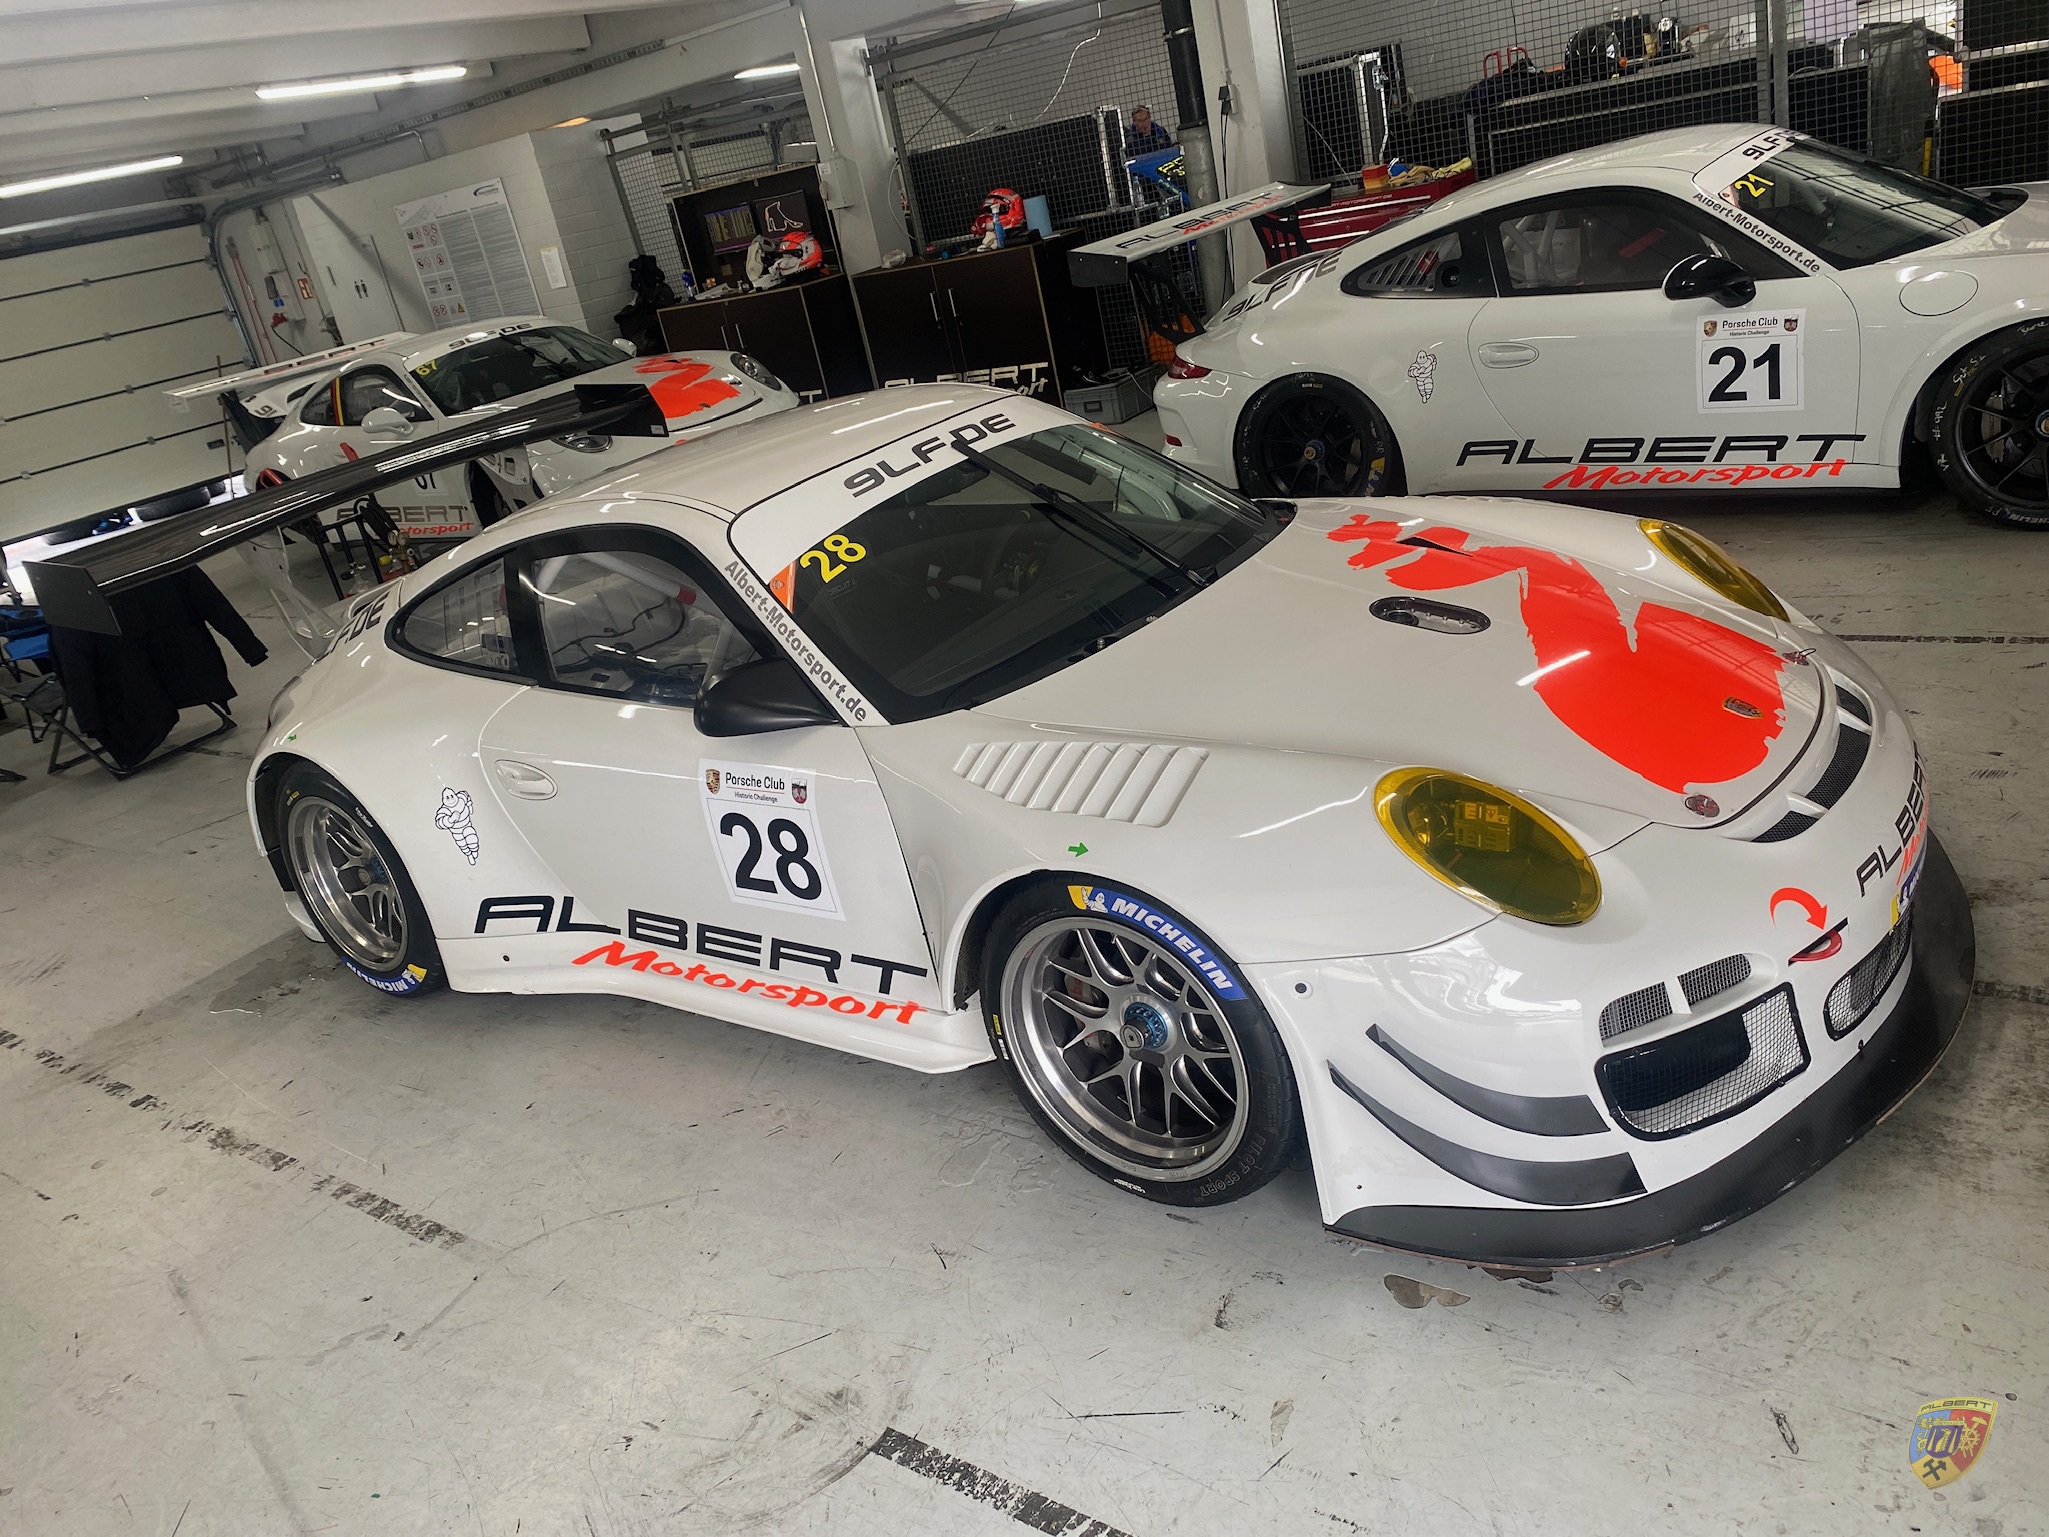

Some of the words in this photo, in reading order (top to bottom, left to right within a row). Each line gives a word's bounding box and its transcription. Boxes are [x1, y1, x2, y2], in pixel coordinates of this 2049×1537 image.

[1734, 173, 1775, 198] 21
[1115, 192, 1272, 250] ALBERT
[1693, 192, 1820, 273] Albert-Motorsport.de
[1722, 319, 1757, 329] Porsche
[1758, 317, 1778, 326] Club
[415, 359, 438, 376] 67
[1708, 343, 1781, 403] 21
[843, 413, 1017, 498] 9LFDE
[1456, 434, 1867, 467] ALBERT
[1542, 458, 1855, 491] Motorsport
[336, 505, 468, 523] ABERT
[799, 534, 867, 584] 28
[724, 560, 867, 722] Albert-Motorsport.de
[725, 772, 762, 789] Porsche
[763, 777, 785, 791] Club
[734, 791, 753, 801] Historic
[753, 793, 778, 804] Challenge
[719, 812, 823, 901] 28
[473, 895, 928, 995] ALBERT
[1111, 897, 1234, 990] MICHELIN
[345, 960, 410, 993] MICHELIN
[571, 940, 928, 1025] Motorsport
[1200, 1170, 1240, 1197] SPORT
